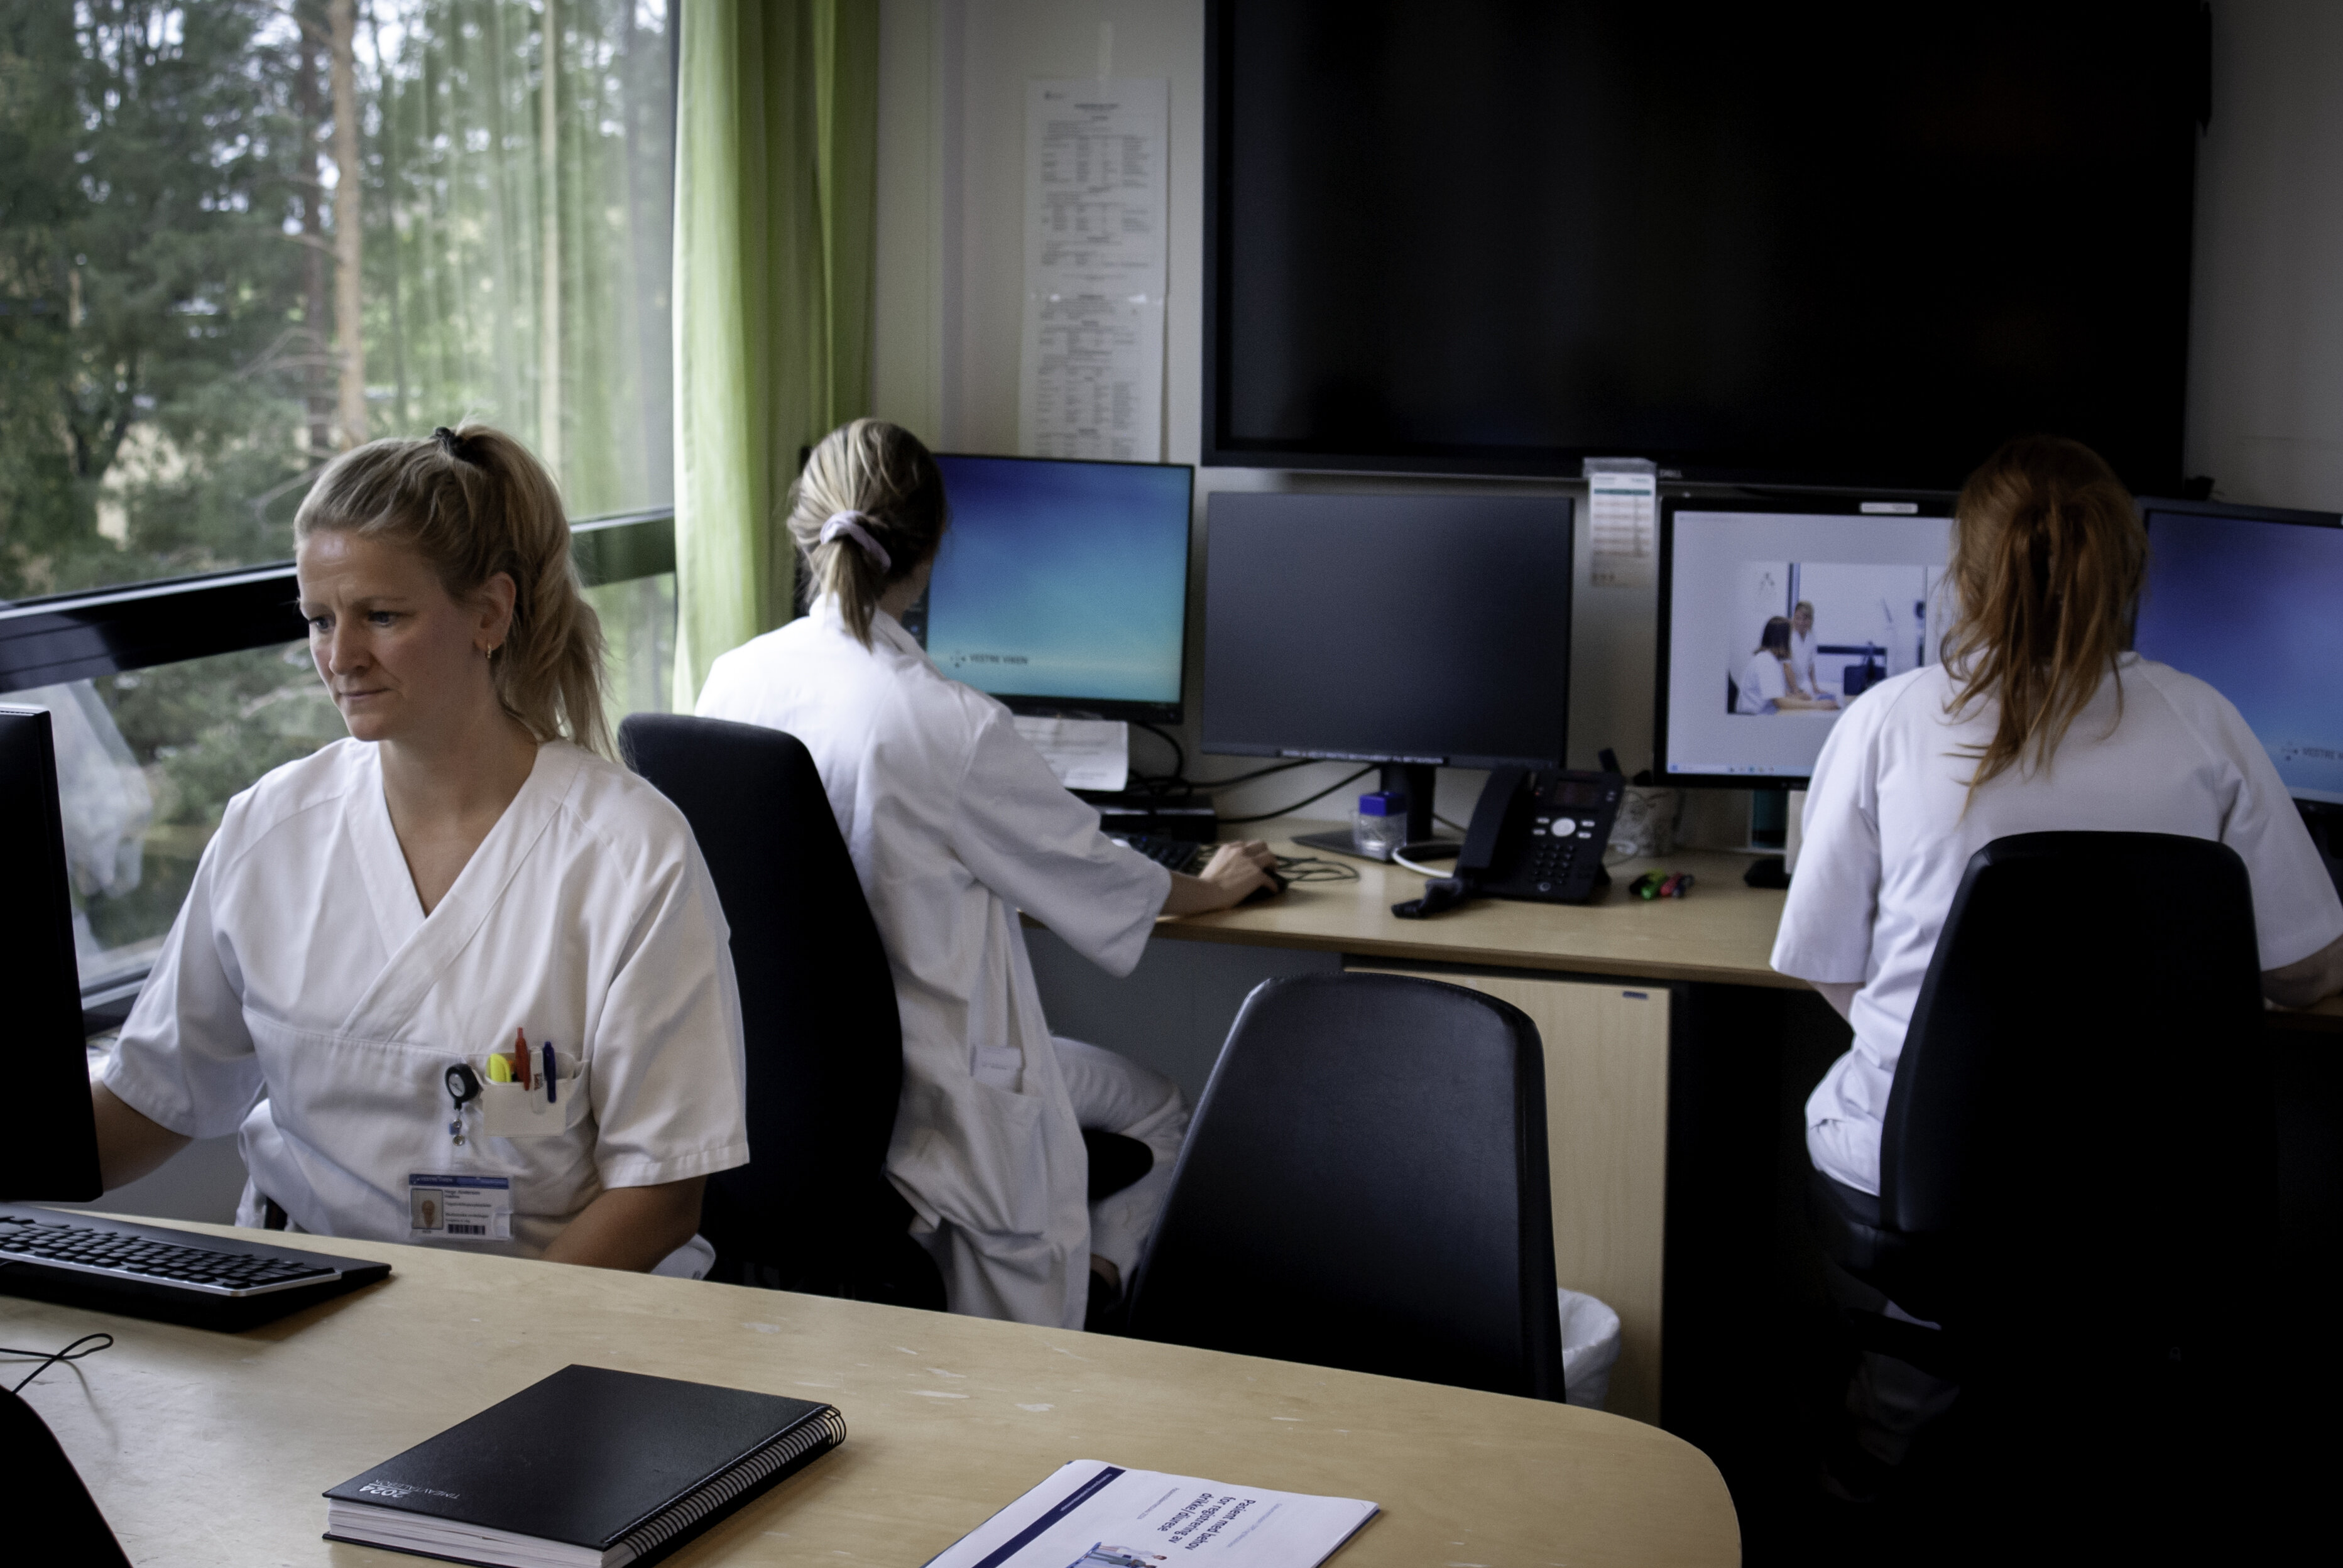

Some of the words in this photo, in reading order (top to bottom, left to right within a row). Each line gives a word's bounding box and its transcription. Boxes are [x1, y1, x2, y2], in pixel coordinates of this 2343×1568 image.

[969, 654, 999, 663] VESTRE
[359, 1484, 410, 1498] 2024
[376, 1479, 461, 1500] TIMEAVTALEBOK
[1217, 1496, 1236, 1505] for
[1223, 1499, 1256, 1520] Pasient
[1157, 1493, 1214, 1531] drikke/diurese
[1174, 1505, 1222, 1536] registrering
[1207, 1519, 1229, 1533] med
[1185, 1532, 1216, 1550] behov
